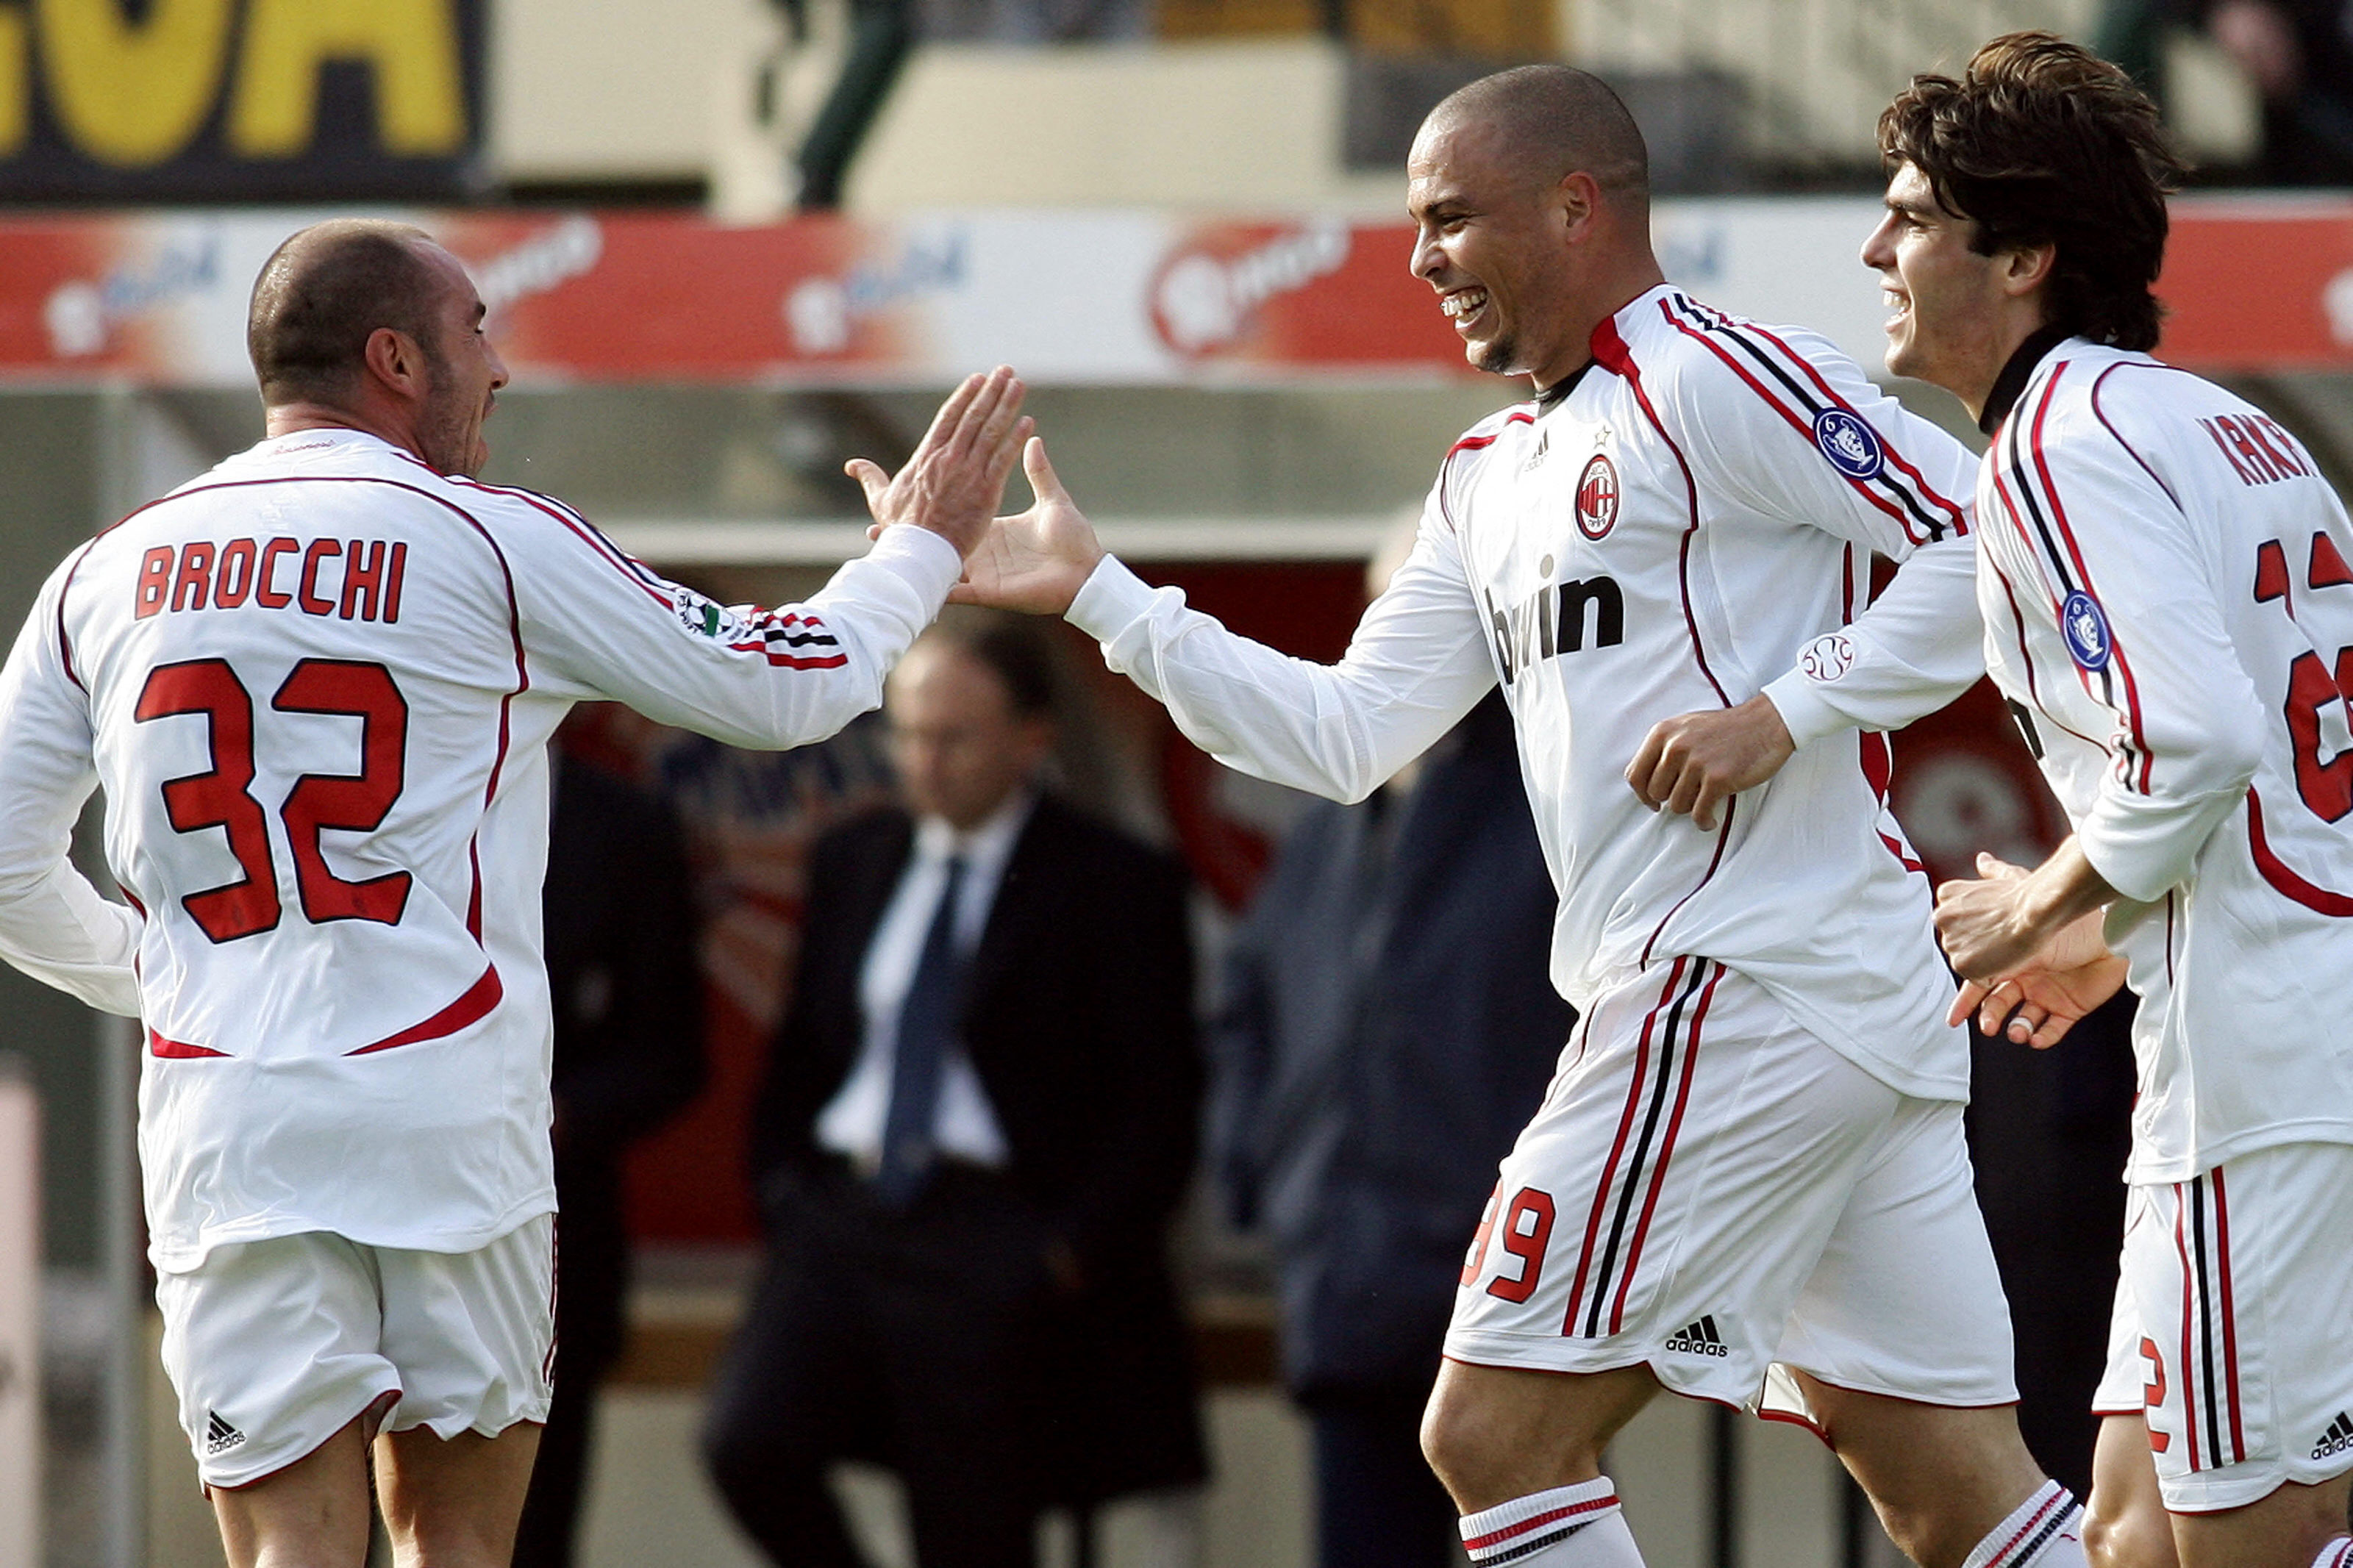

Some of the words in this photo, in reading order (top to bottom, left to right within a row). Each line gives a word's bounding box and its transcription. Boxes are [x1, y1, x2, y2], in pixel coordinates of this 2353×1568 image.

[1825, 417, 1836, 432] 6
[135, 537, 407, 625] BROCCHI
[1485, 554, 1624, 685] bwin
[134, 657, 413, 945] 32
[1665, 1337, 1729, 1358] adidas
[207, 1430, 247, 1455] adidas
